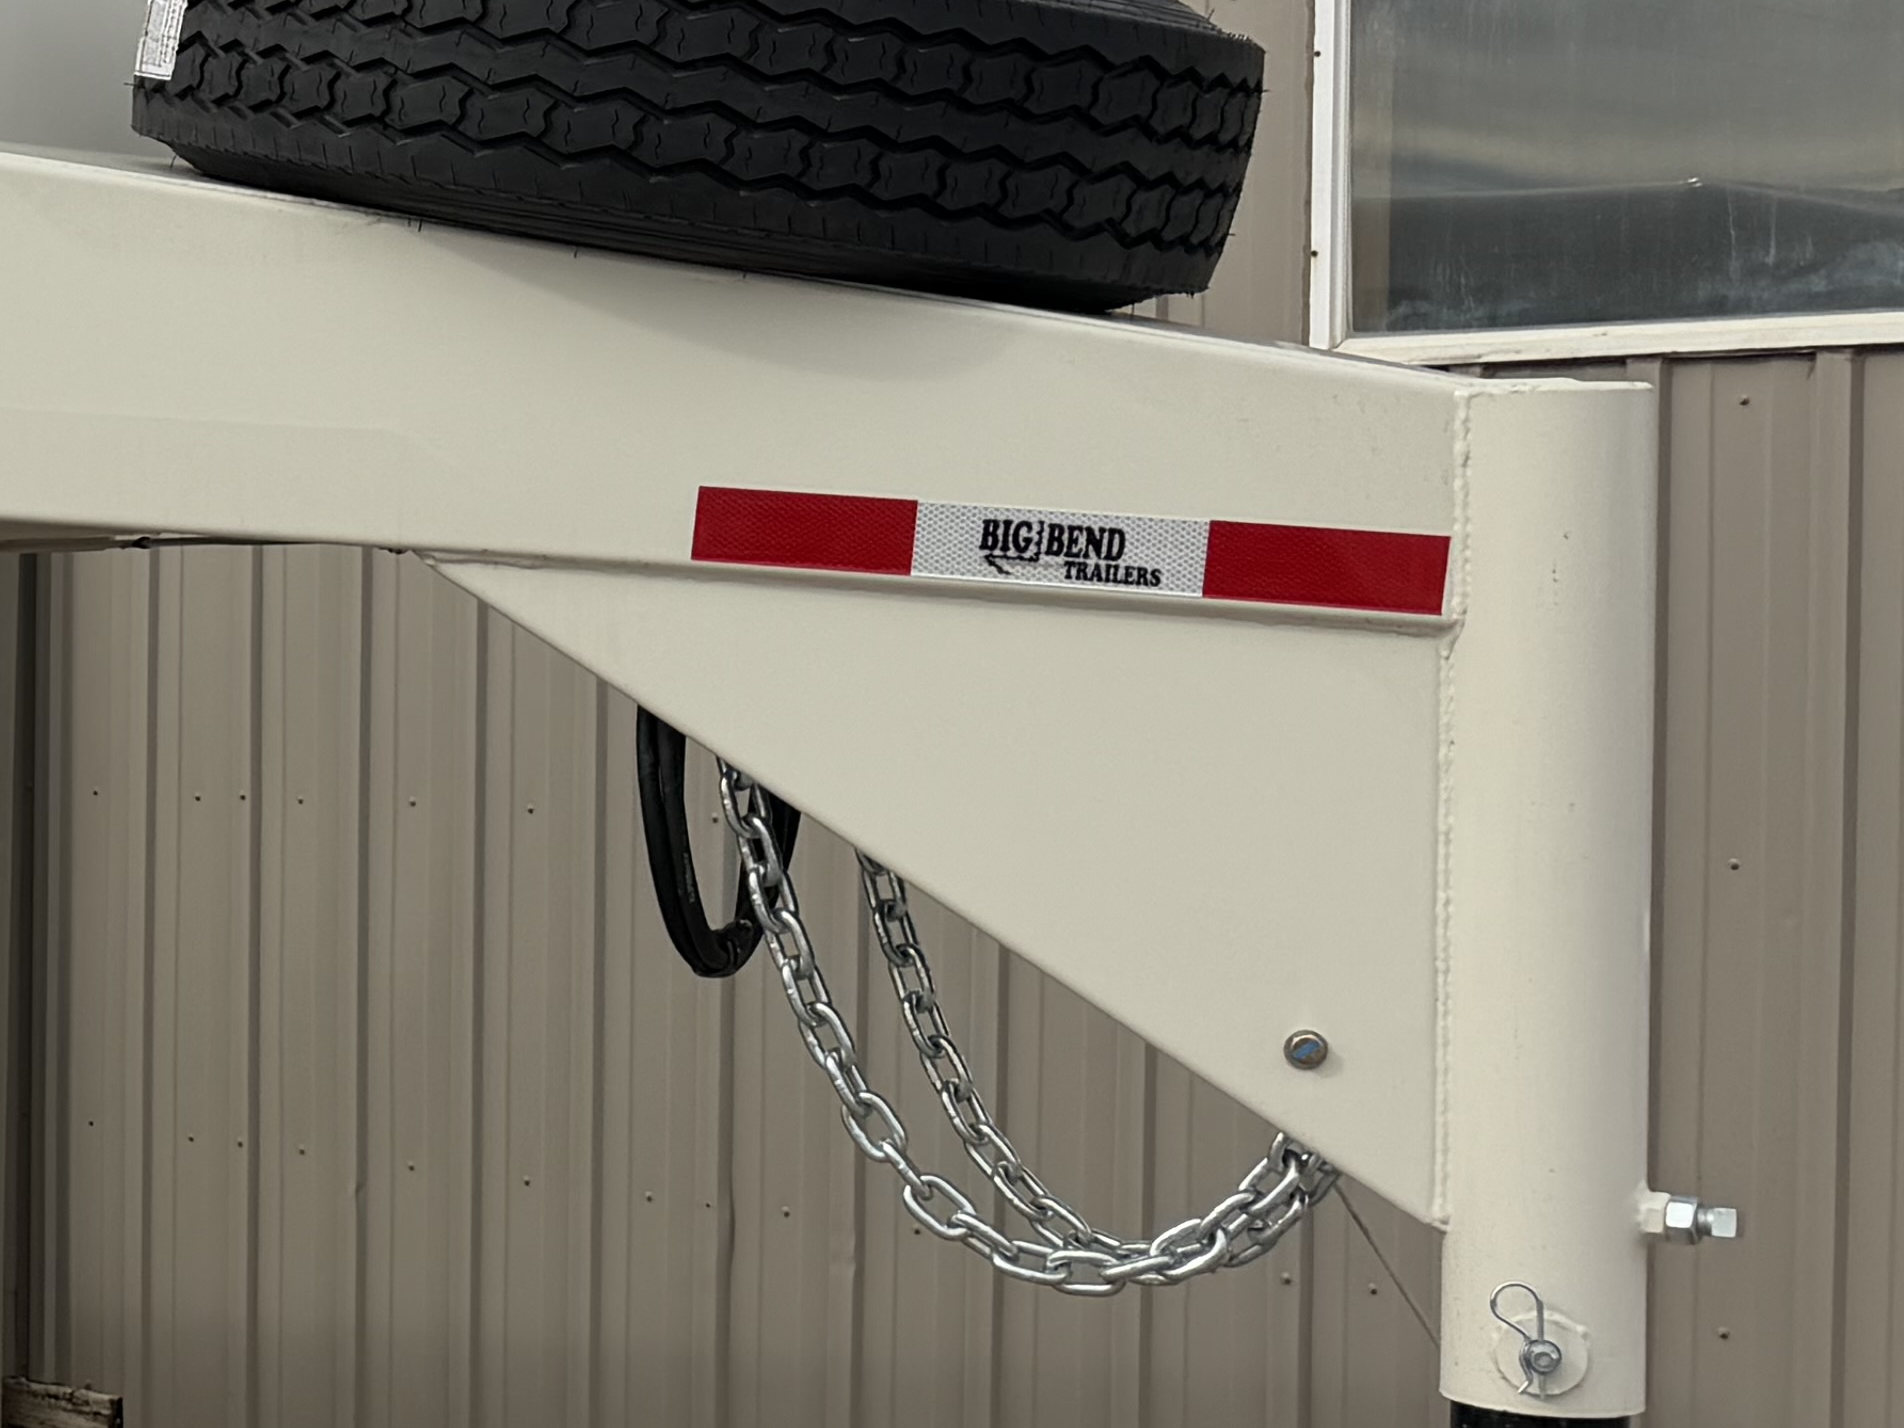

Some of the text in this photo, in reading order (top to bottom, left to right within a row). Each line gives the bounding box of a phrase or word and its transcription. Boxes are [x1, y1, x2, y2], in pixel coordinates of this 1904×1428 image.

[979, 519, 1126, 561] BIG BEND
[1064, 560, 1162, 587] TRAILERS
